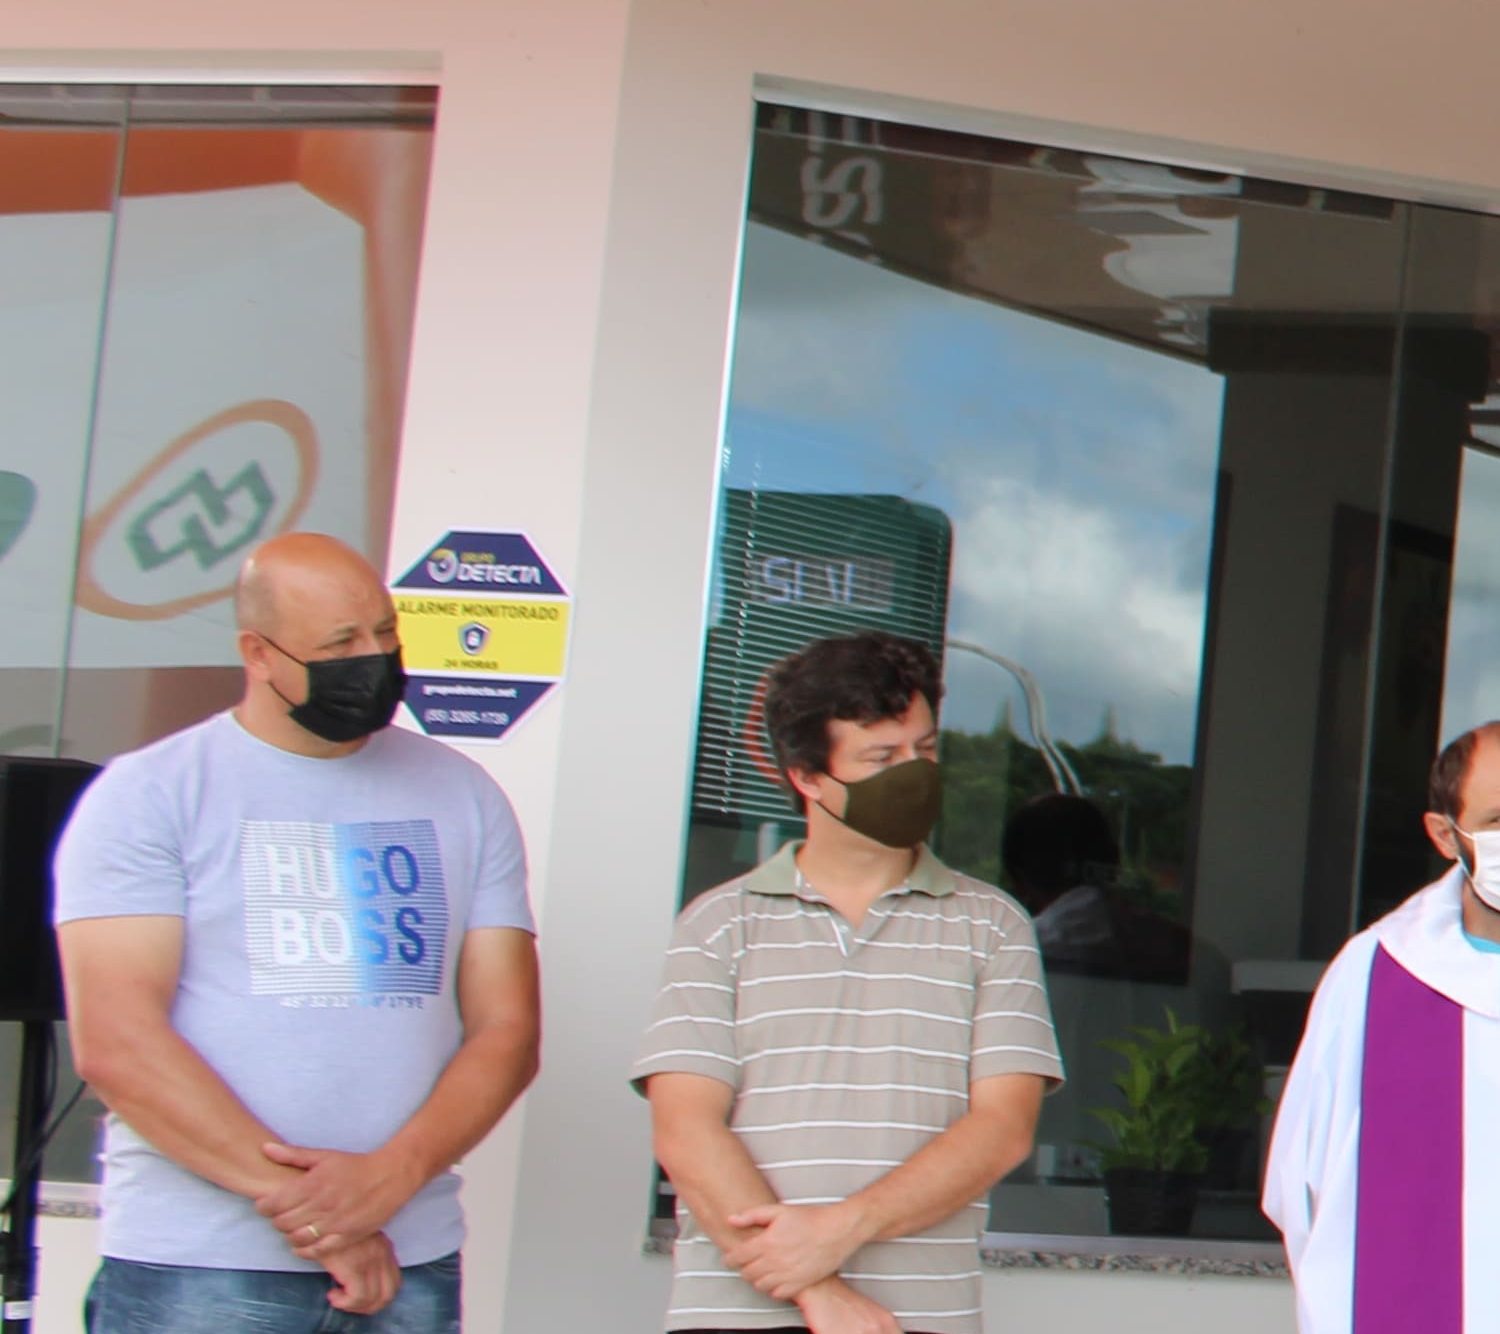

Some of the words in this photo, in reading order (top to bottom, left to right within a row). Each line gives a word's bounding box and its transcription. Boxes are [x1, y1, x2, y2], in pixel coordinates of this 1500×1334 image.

[456, 562, 543, 586] DETECTA
[398, 600, 457, 616] ALARME
[460, 604, 559, 621] MONITORADO
[265, 844, 421, 900] HUGO
[273, 906, 426, 965] BOSS
